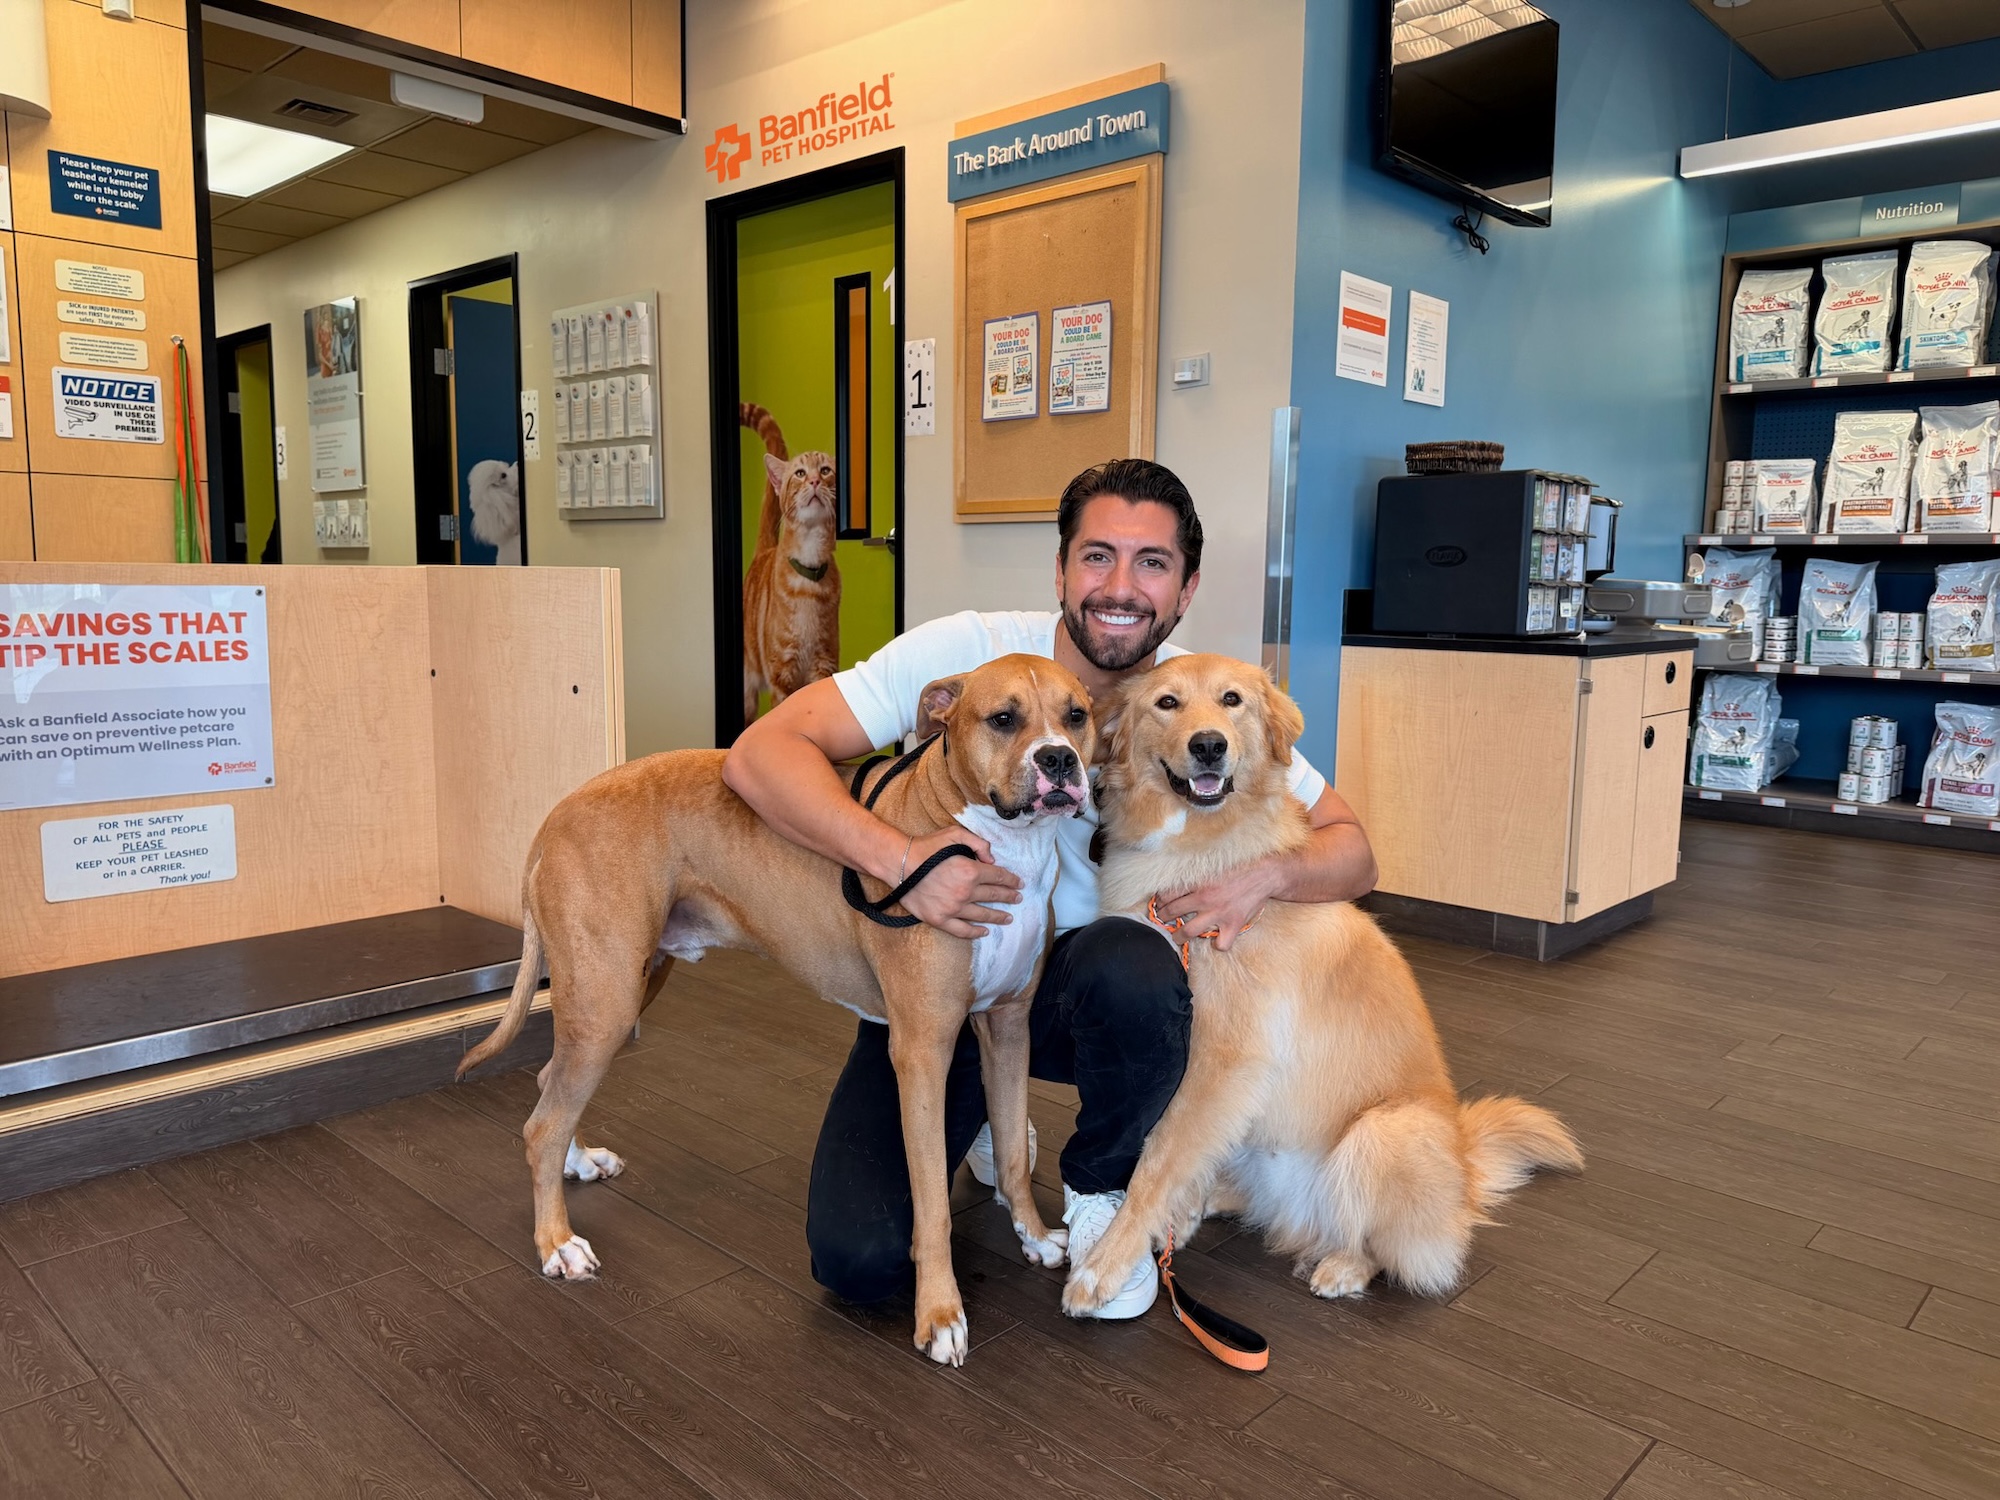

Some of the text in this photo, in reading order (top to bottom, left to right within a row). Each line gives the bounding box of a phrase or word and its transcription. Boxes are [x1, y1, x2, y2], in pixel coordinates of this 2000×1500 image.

[760, 73, 893, 147] Banfield
[762, 112, 895, 166] PET HOSPITAL
[954, 110, 1146, 176] The Bark Around Town
[60, 156, 148, 181] Please keep your pet
[62, 168, 96, 182] leashed
[109, 177, 148, 190] kenneled
[67, 180, 144, 202] while in the lobby
[98, 196, 113, 205] the
[114, 198, 139, 210] scale.
[1876, 202, 1944, 220] Nutrition
[883, 266, 895, 326] 1
[1061, 313, 1102, 328] YOUR DOG
[993, 328, 1030, 342] YOUR DOG
[1064, 327, 1081, 336] COULD
[1066, 335, 1084, 343] BOARD
[1086, 332, 1102, 341] GAME
[64, 378, 152, 400] NOTICE
[912, 370, 926, 408] 1
[65, 398, 155, 412] VIDEO SURVEILLANCE
[115, 424, 156, 434] PREMISES
[130, 418, 156, 427] THESE
[525, 412, 535, 440] 2
[278, 443, 285, 466] 3
[1956, 446, 1977, 454] ANIN
[0, 612, 248, 638] SAVINGS THAT
[0, 640, 249, 668] TIP THE SCALES
[29, 718, 40, 727] a
[43, 712, 108, 727] Banfield
[112, 708, 184, 722] Associate
[187, 707, 218, 719] how
[220, 707, 246, 721] you
[31, 732, 69, 743] save
[72, 730, 92, 741] on
[96, 724, 176, 742] preventive
[180, 722, 234, 738] petcare
[0, 736, 242, 762] with an Optimum Wellness Plan.
[224, 761, 256, 769] Banfield
[98, 815, 184, 830] FOR THE SAFETY
[73, 824, 208, 846] OF ALL PETS and PEOPLE
[122, 839, 164, 852] PLEASE
[76, 848, 209, 870] KEEP YOUR PET LEASHED
[103, 871, 115, 879] or
[117, 868, 127, 878] in
[140, 863, 186, 875] CARRIER.
[160, 870, 211, 884] Thank you!
